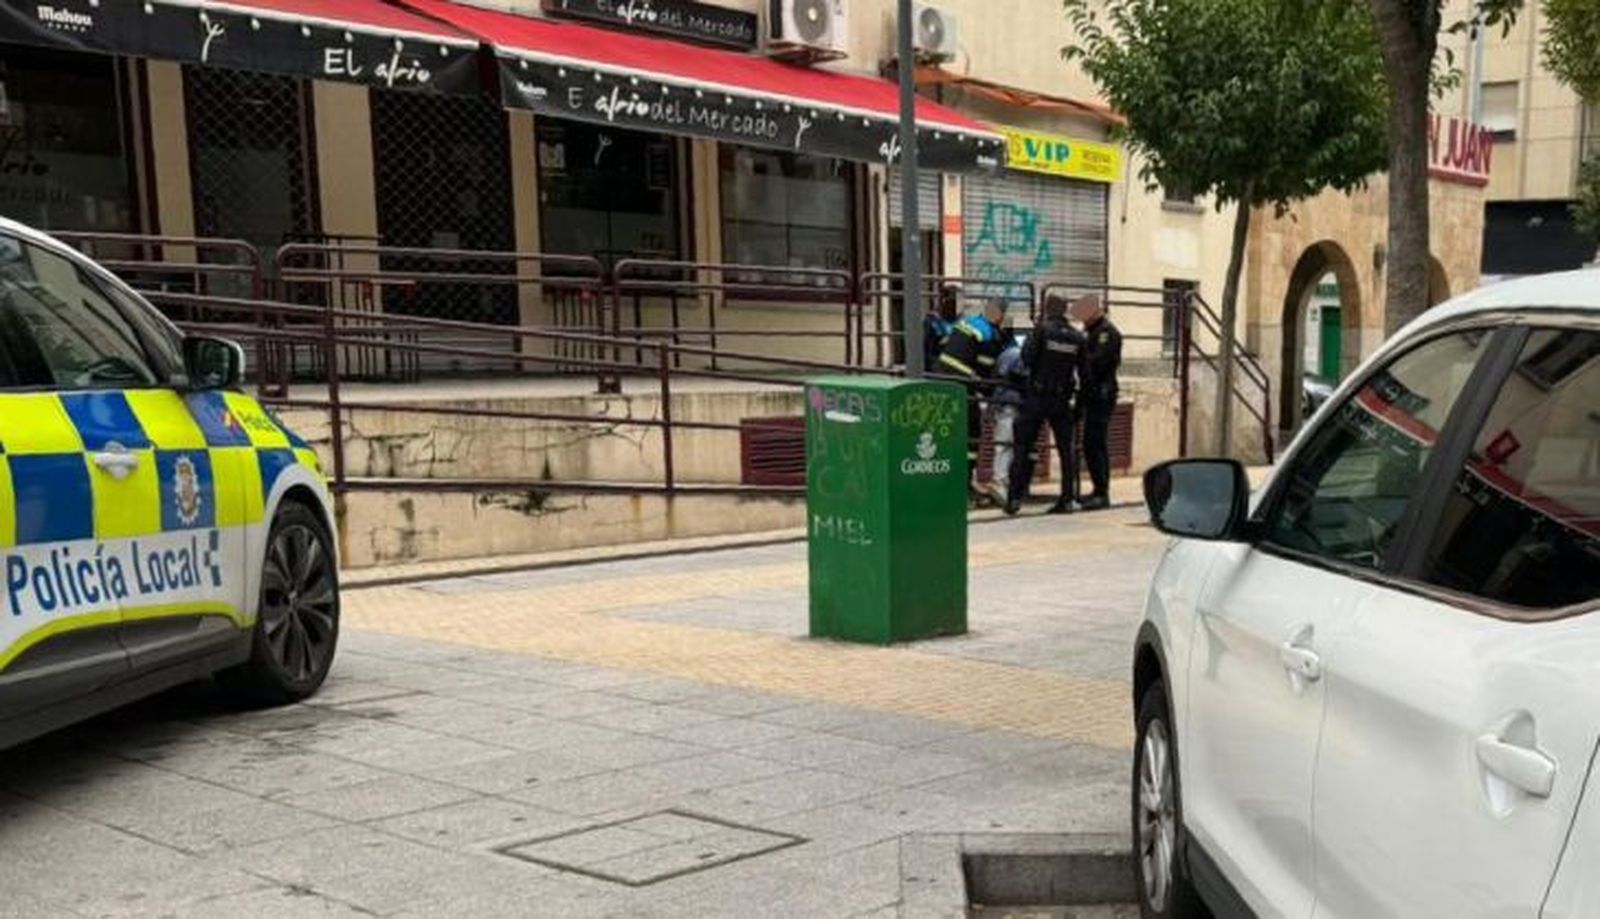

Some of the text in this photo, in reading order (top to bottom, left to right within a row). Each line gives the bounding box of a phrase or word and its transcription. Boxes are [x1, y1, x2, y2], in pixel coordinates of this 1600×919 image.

[37, 6, 93, 27] Mahou
[651, 99, 684, 124] del
[688, 104, 779, 138] Mercado
[1023, 136, 1070, 164] VIP
[1442, 117, 1496, 176] JUAN
[5, 536, 202, 617] Policía Local
